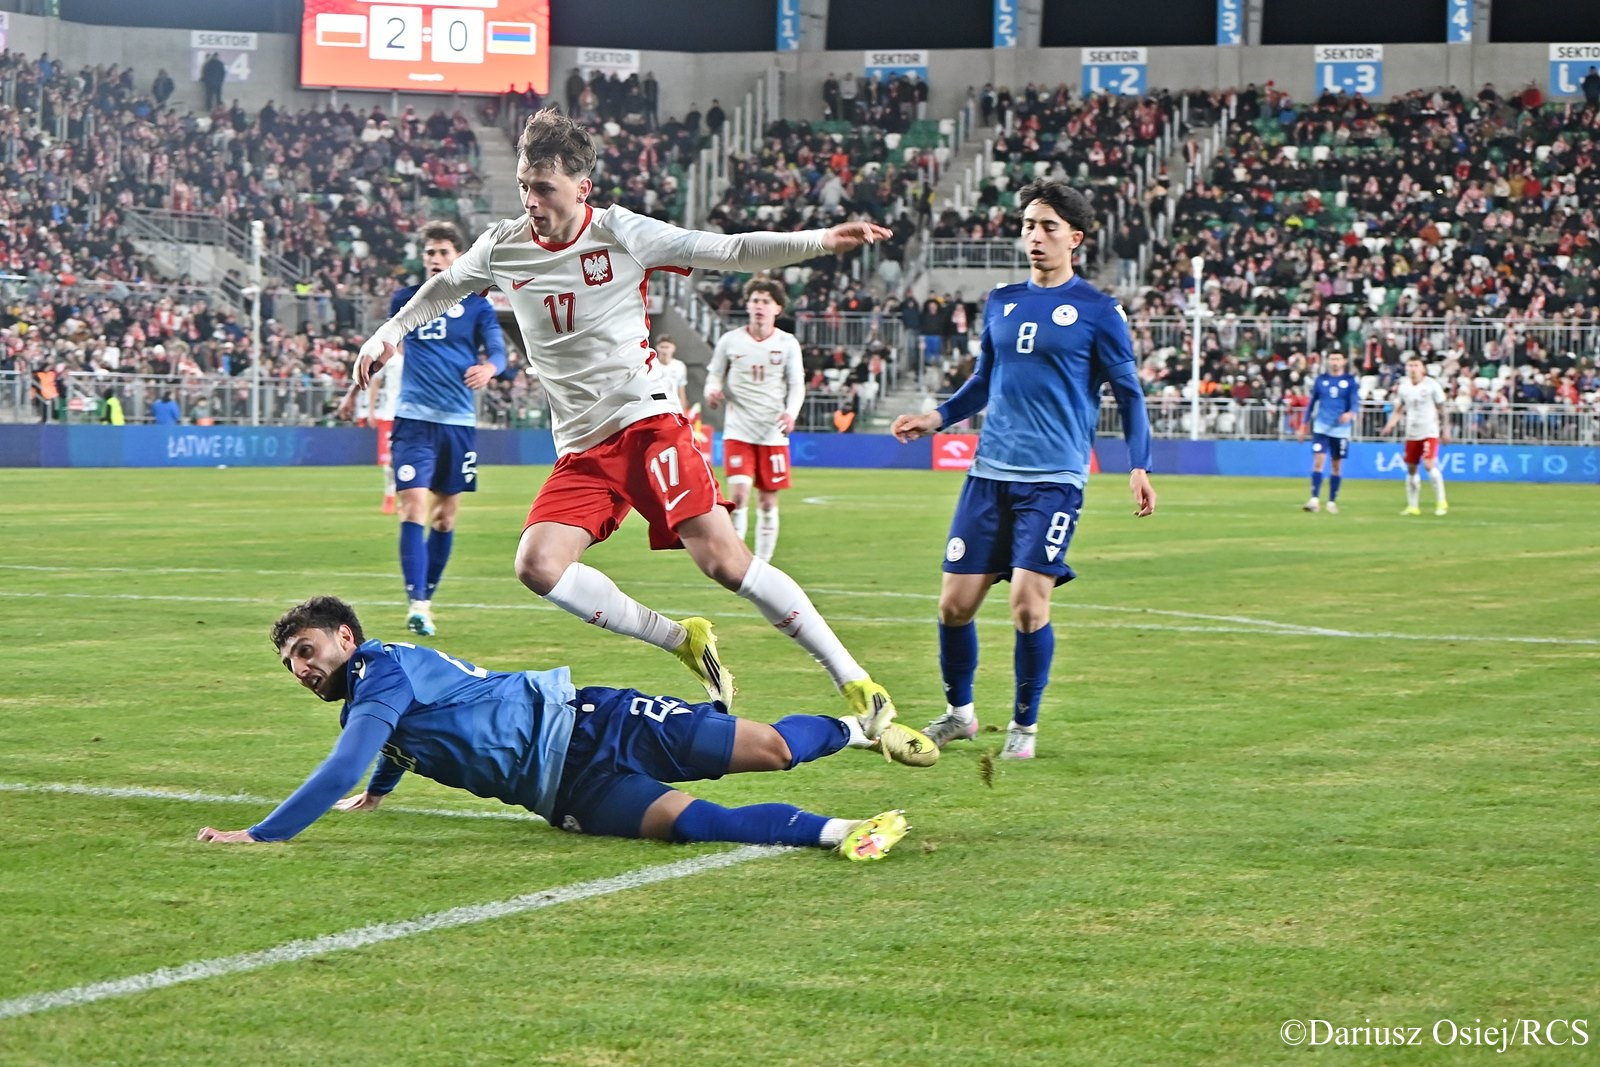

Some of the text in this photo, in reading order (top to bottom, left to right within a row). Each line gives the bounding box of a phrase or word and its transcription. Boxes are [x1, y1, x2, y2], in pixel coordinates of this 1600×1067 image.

[199, 34, 250, 46] SEKTOR
[386, 17, 406, 49] 2
[448, 20, 468, 52] 0
[584, 51, 632, 64] SEKTOR
[872, 53, 921, 65] SEKTOR
[1089, 51, 1140, 62] SEKTOR
[1323, 48, 1375, 60] SEKTOR
[1558, 47, 1600, 58] SEKTO
[1090, 67, 1140, 95] L-2
[1323, 65, 1376, 93] L-3
[543, 291, 576, 334] 17
[417, 316, 447, 341] 23
[1016, 322, 1038, 354] 8
[751, 364, 765, 382] 11
[650, 446, 680, 493] 17
[769, 454, 786, 473] 11
[1045, 511, 1071, 545] 8
